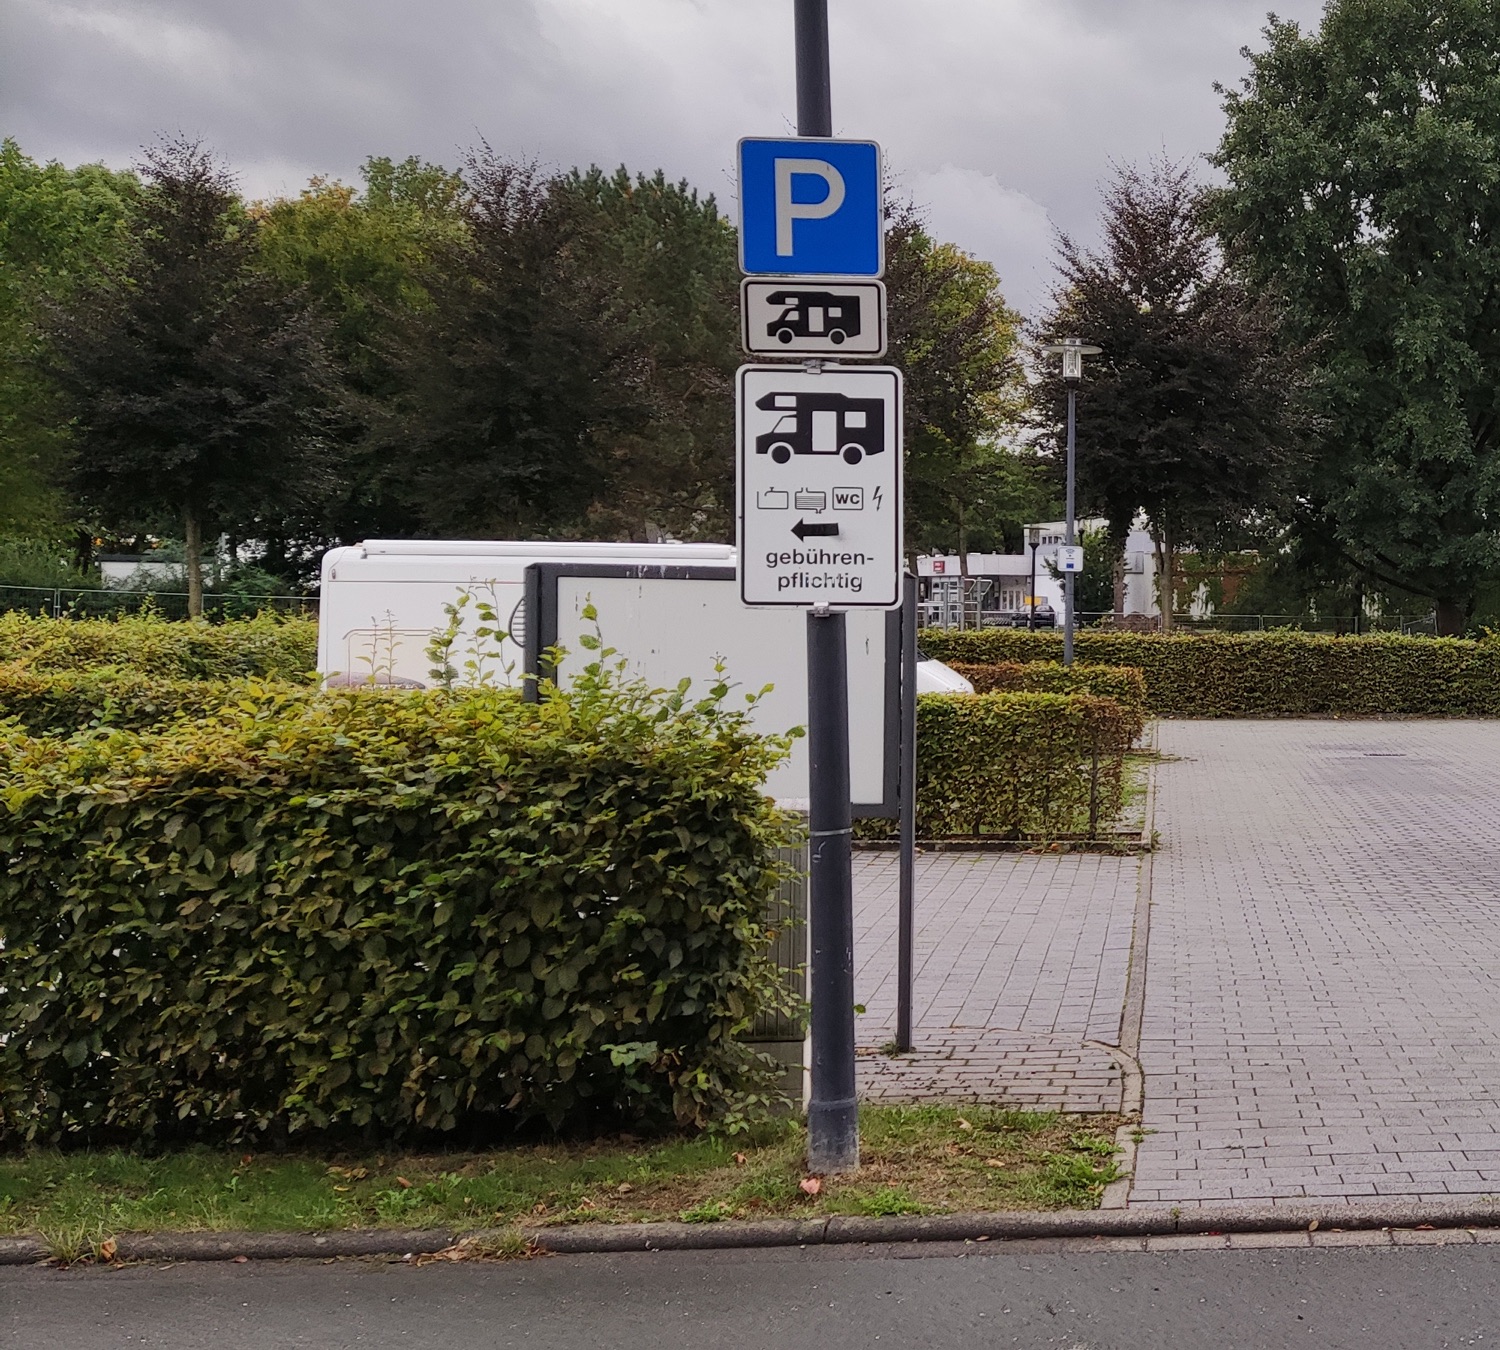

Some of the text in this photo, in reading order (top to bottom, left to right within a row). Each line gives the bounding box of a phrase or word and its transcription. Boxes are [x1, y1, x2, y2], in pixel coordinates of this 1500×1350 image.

[774, 157, 846, 257] P
[835, 493, 861, 505] WC
[766, 548, 875, 569] gebühren-
[777, 571, 863, 593] pflichtig
